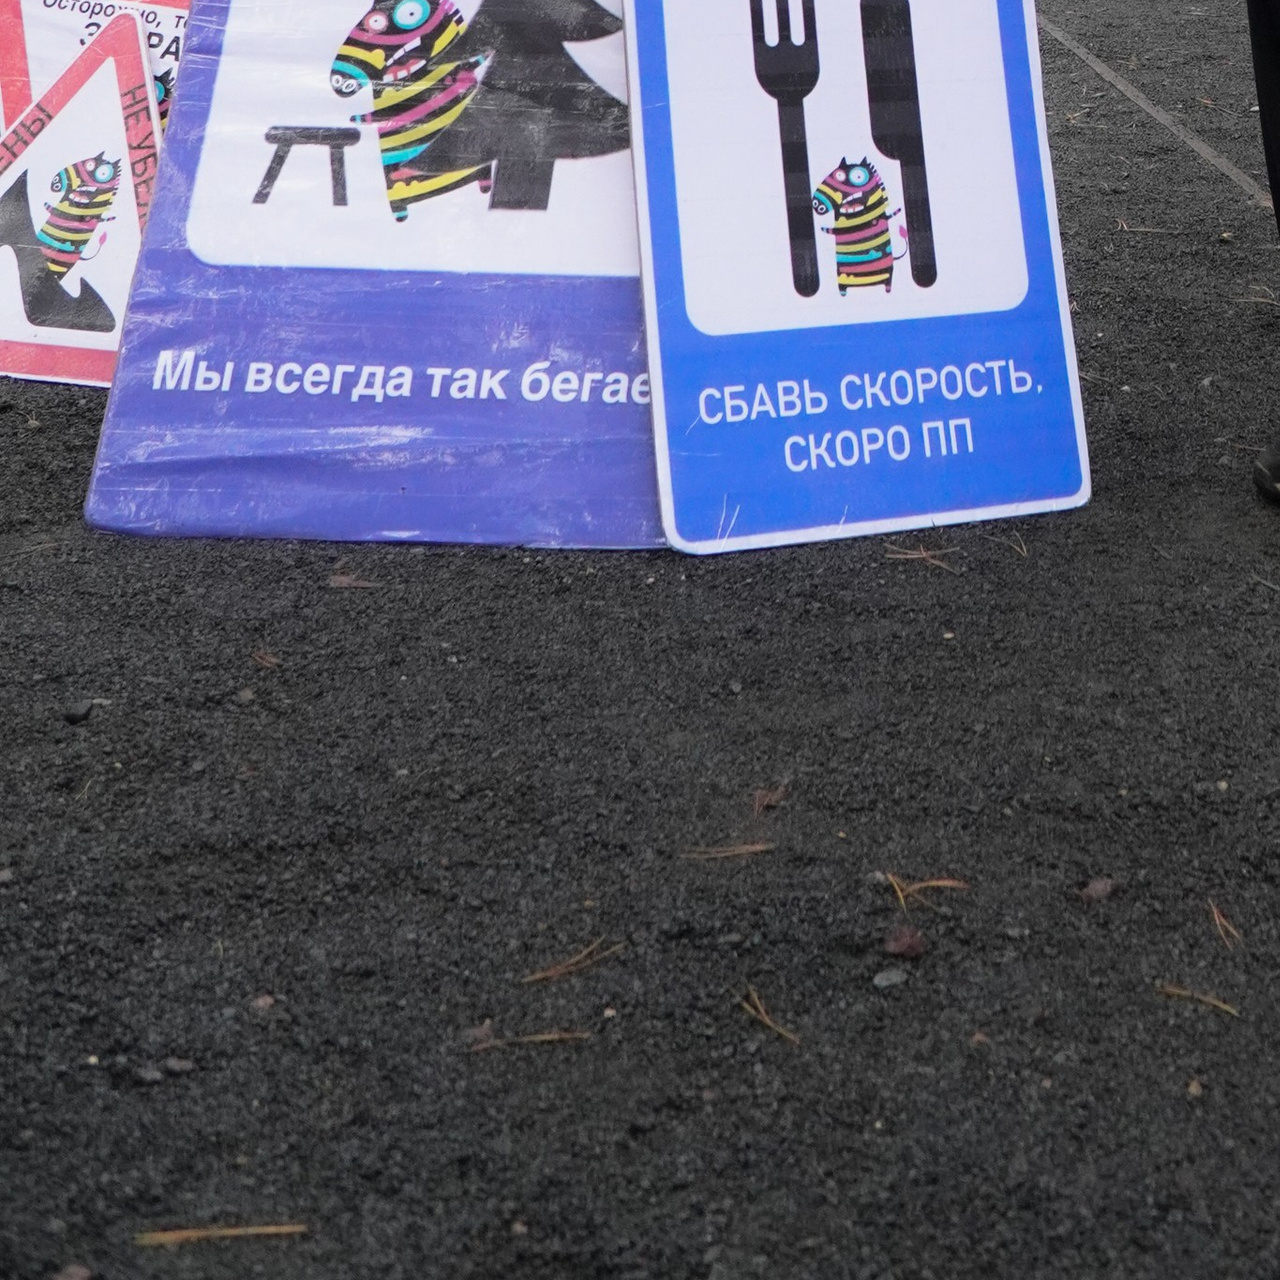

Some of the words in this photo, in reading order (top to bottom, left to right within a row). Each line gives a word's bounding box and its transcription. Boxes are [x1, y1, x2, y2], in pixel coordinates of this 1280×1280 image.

[152, 349, 233, 392] Мы
[244, 361, 412, 403] всегда
[426, 364, 510, 401] так
[698, 378, 829, 425] СБАВЬ
[839, 358, 1044, 411] СКОРОСТЬ,
[783, 424, 911, 473] СКОРО
[922, 417, 975, 458] ПП
